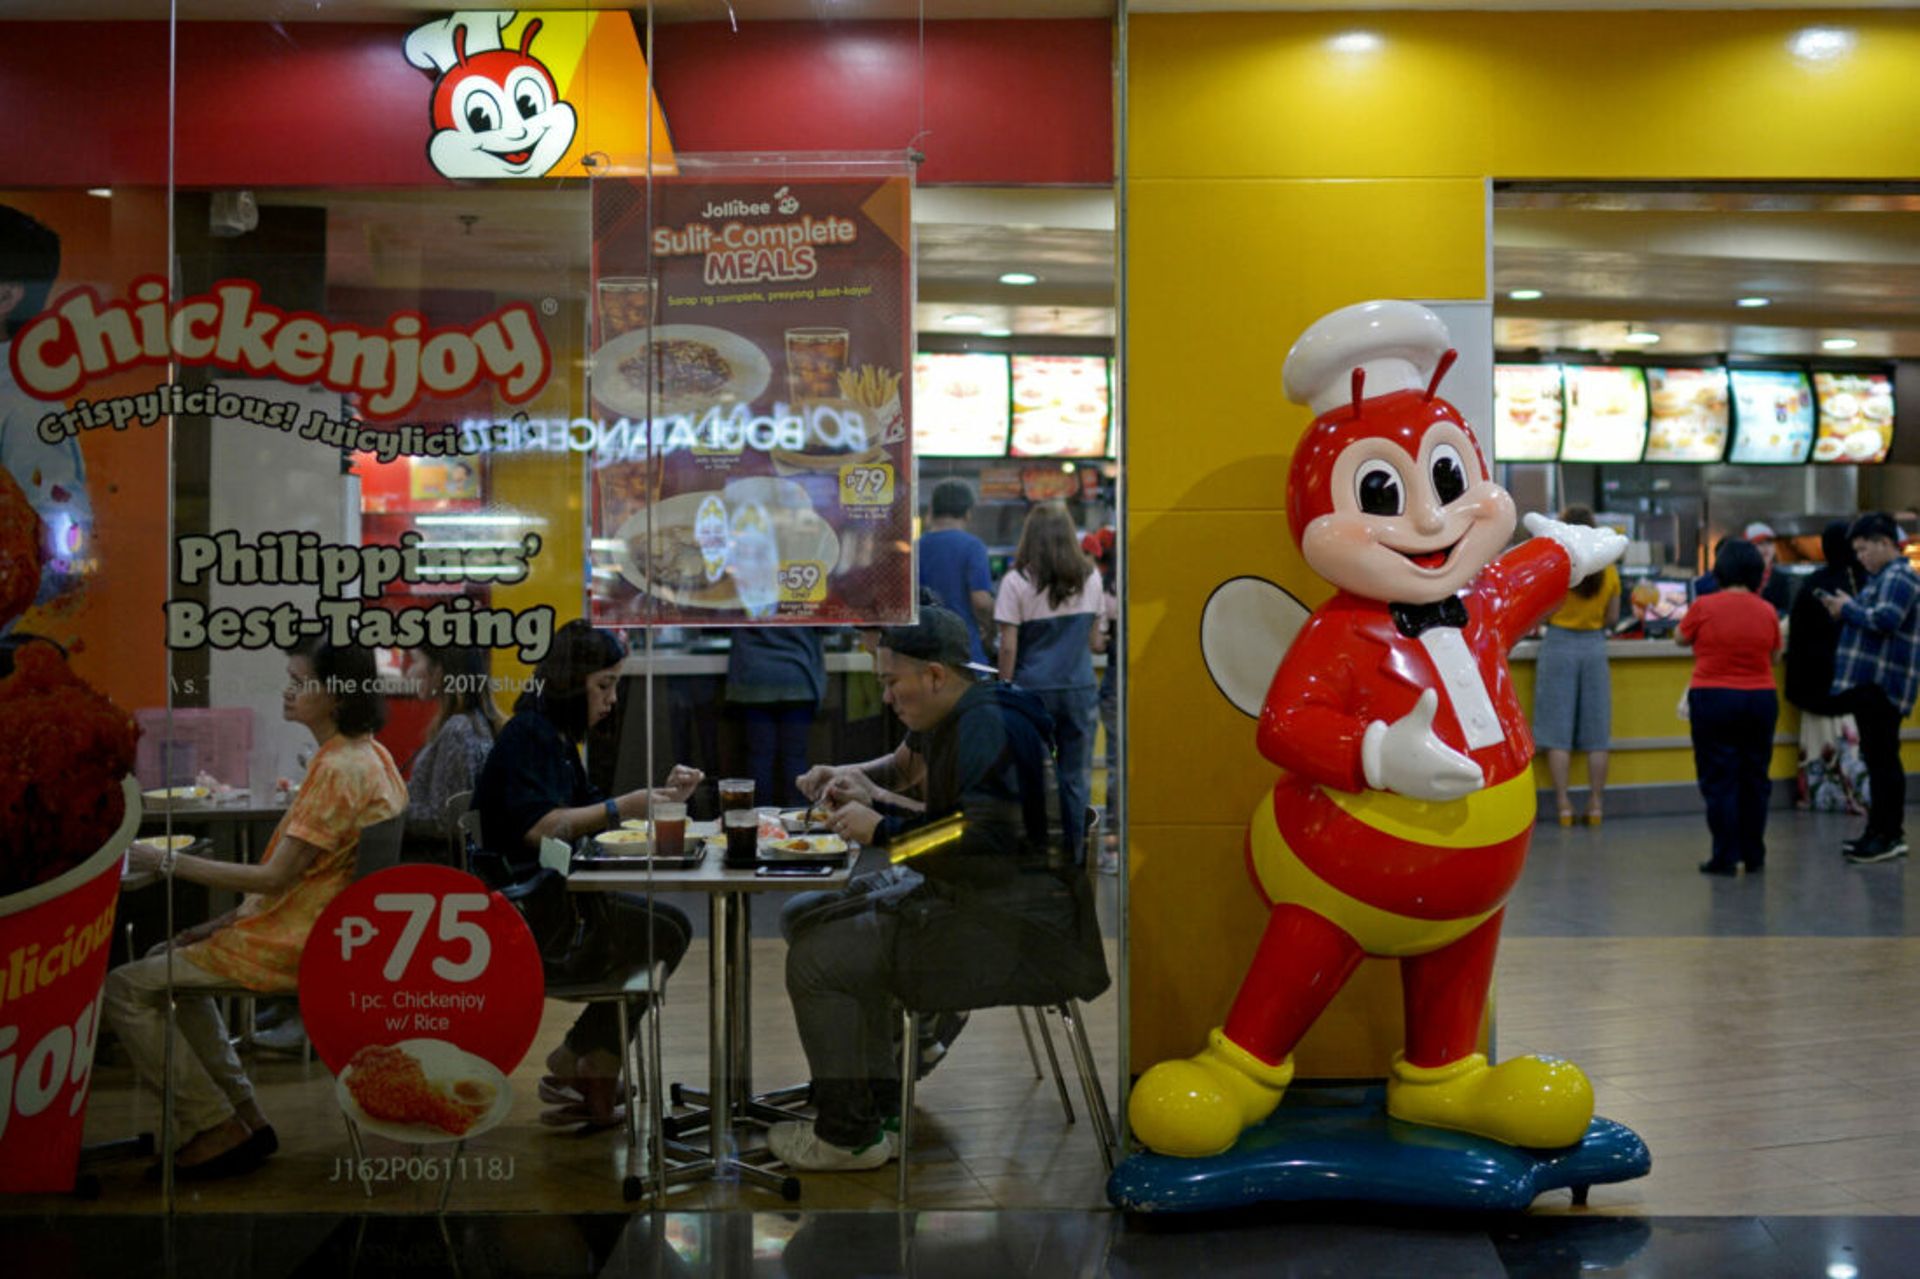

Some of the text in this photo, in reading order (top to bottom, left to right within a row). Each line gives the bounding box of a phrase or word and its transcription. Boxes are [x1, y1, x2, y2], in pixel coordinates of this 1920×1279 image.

[702, 199, 771, 219] Jollibee
[653, 215, 856, 255] Sulit-Complete
[704, 246, 818, 285] MEALS
[9, 275, 551, 420] Chickenjoy
[37, 384, 301, 445] Crispylicious!
[177, 530, 542, 599] Philippines'
[164, 597, 556, 664] Best-Tasting
[303, 675, 320, 694] in
[326, 674, 357, 694] the
[443, 674, 488, 694] 2017
[490, 673, 546, 699] study
[350, 991, 486, 1012] 1 pc. Chickenjoy
[385, 1013, 450, 1031] w/ Rice
[329, 1156, 515, 1182] J162P061118J
